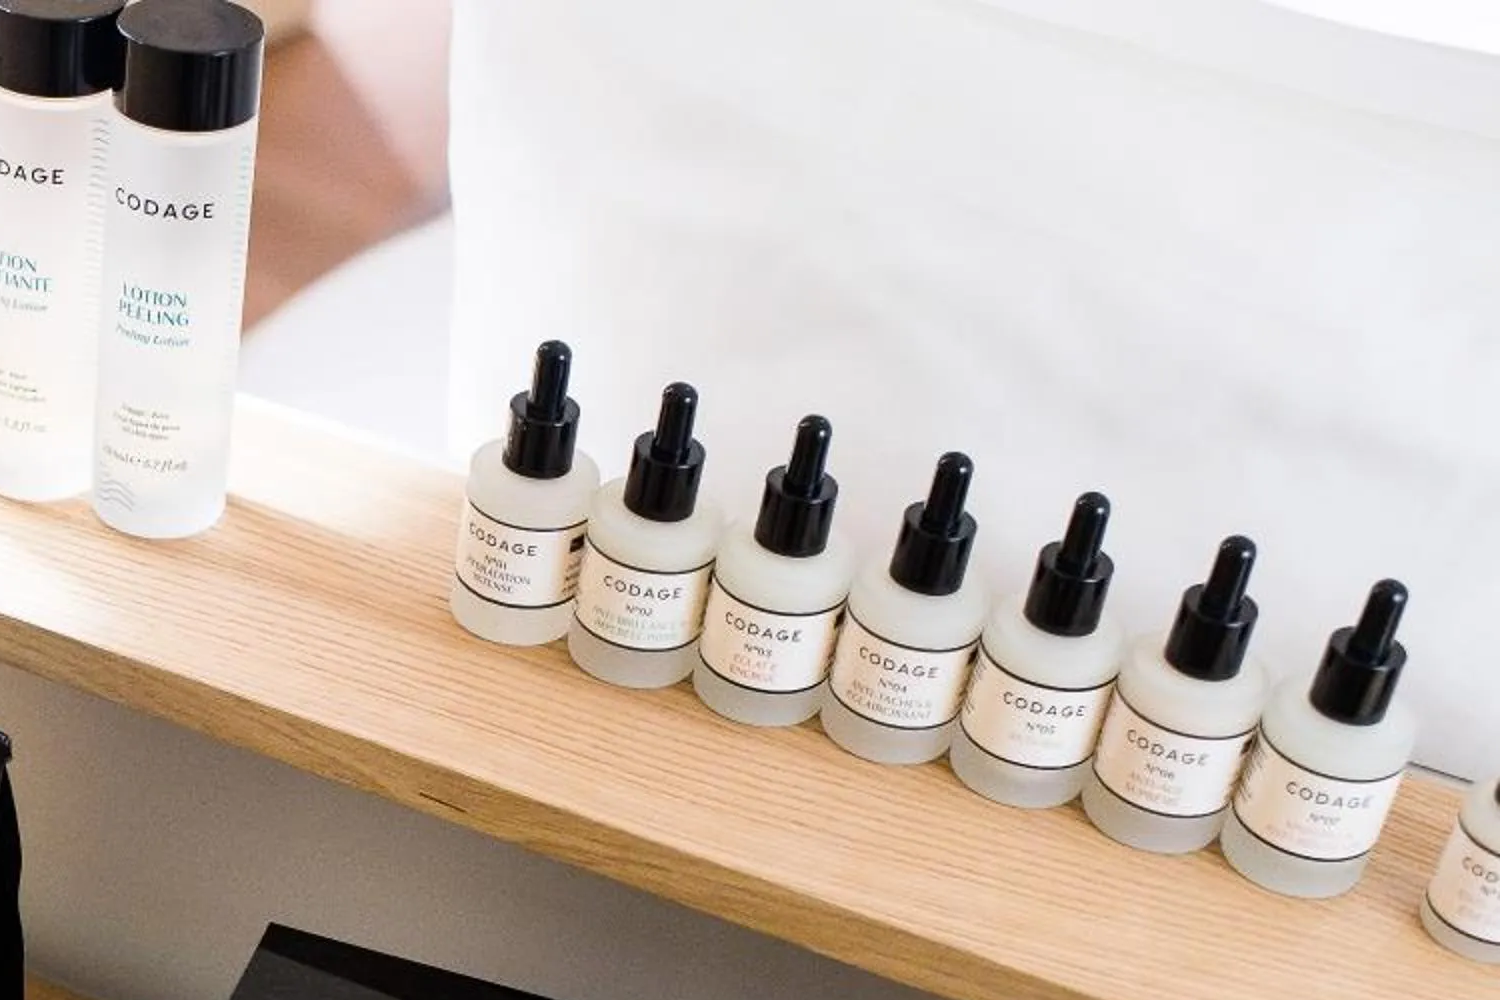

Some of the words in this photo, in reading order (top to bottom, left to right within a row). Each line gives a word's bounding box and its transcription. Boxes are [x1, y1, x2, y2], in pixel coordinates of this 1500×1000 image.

[115, 187, 215, 220] CODAGE
[123, 281, 187, 308] LOTION
[118, 299, 189, 327] PEELING
[469, 522, 538, 556] CODAGE
[603, 575, 683, 601] CODAGE
[725, 611, 802, 642] CODAGE
[859, 646, 939, 679] CODAGE
[1003, 691, 1087, 718] CODAGE
[1127, 729, 1209, 766] CODAGE
[1286, 781, 1375, 809] CODAGE
[1462, 856, 1500, 883] COD
